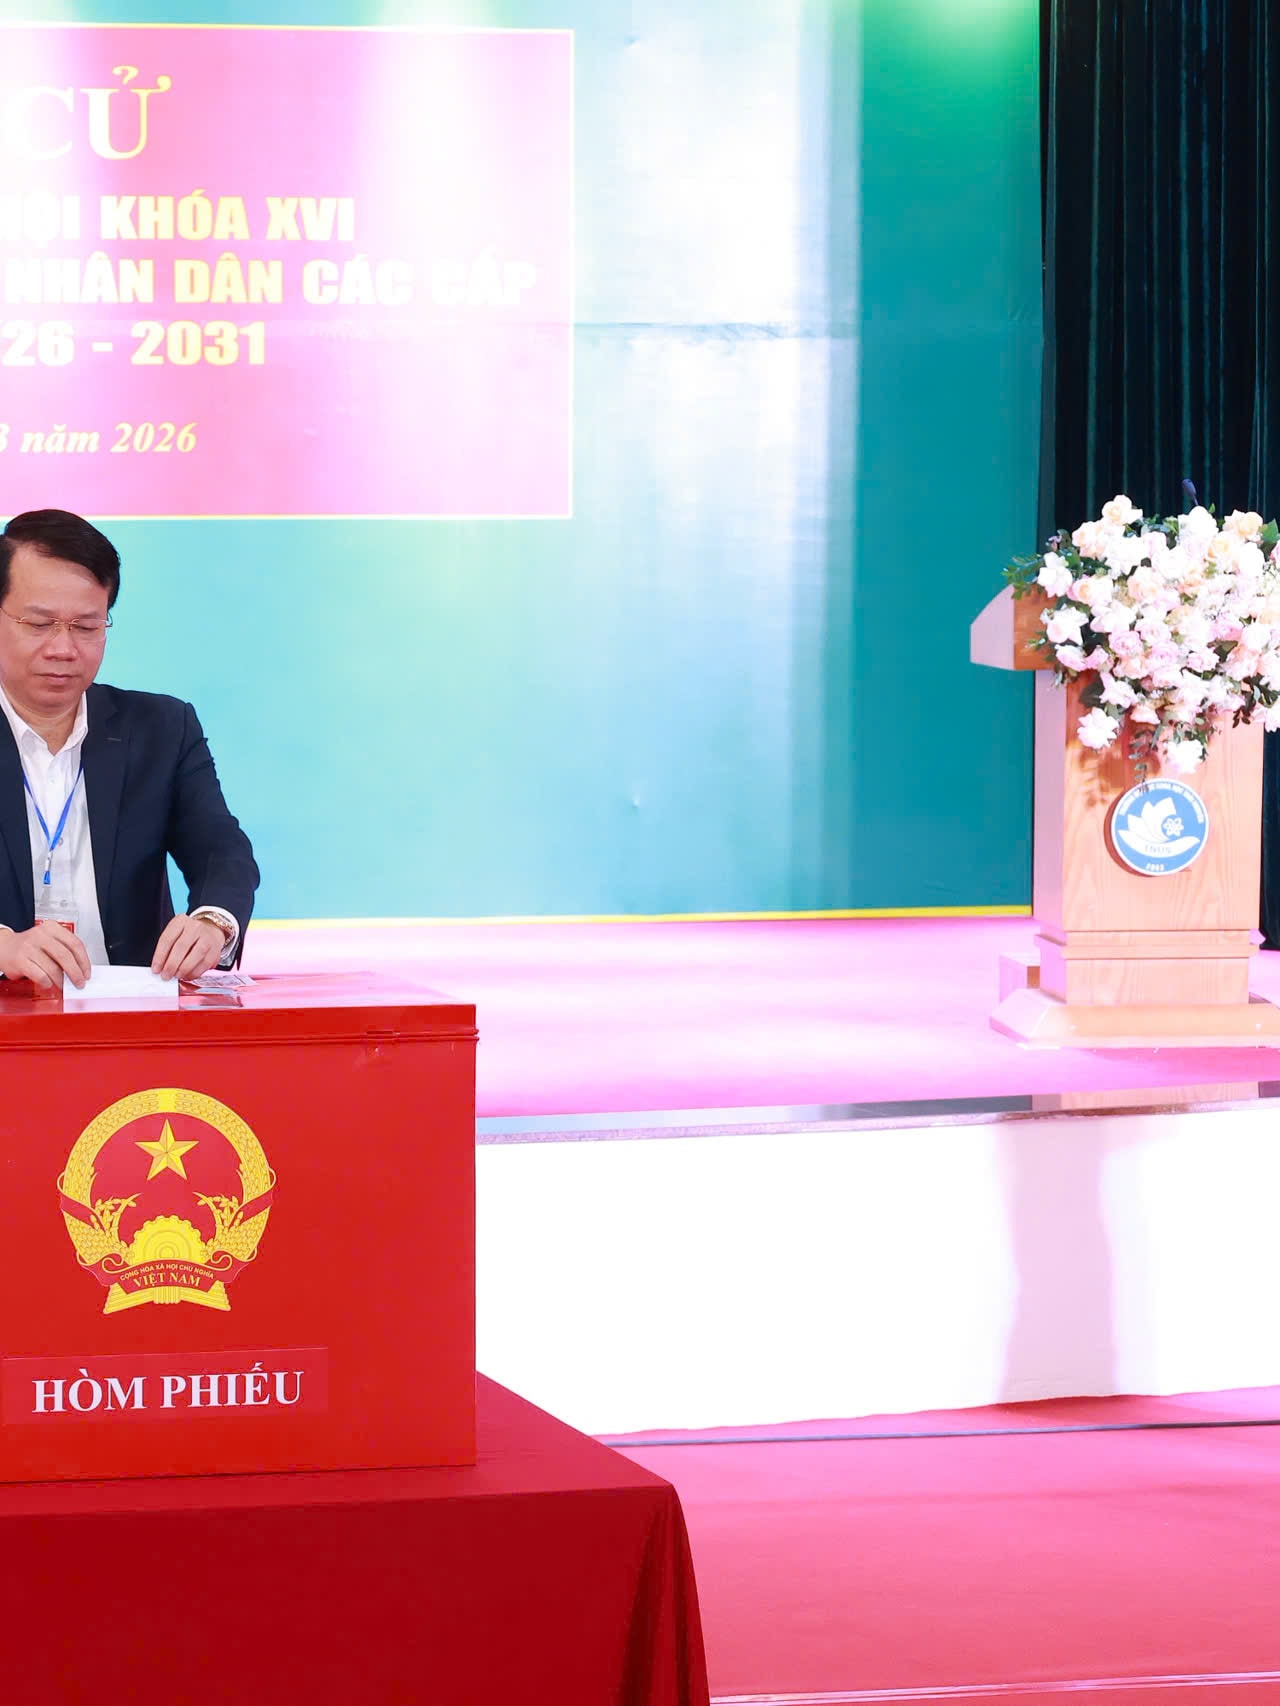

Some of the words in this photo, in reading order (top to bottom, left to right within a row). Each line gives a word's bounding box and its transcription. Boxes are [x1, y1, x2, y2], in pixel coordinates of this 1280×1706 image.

[1, 65, 172, 160] CỬ
[100, 190, 250, 240] KHÓA
[265, 196, 356, 241] XVI
[4, 250, 154, 304] NHÂN
[173, 250, 284, 304] DÂN
[302, 252, 414, 304] CÁC
[430, 245, 538, 305] CẤP
[92, 341, 113, 353] -
[130, 320, 266, 366] 2031
[19, 423, 101, 454] năm
[109, 421, 199, 454] 2026
[133, 1272, 165, 1287] VIỆT
[169, 1272, 200, 1287] NAM
[31, 1368, 148, 1413] HÒM
[159, 1362, 305, 1409] PHIẾU
